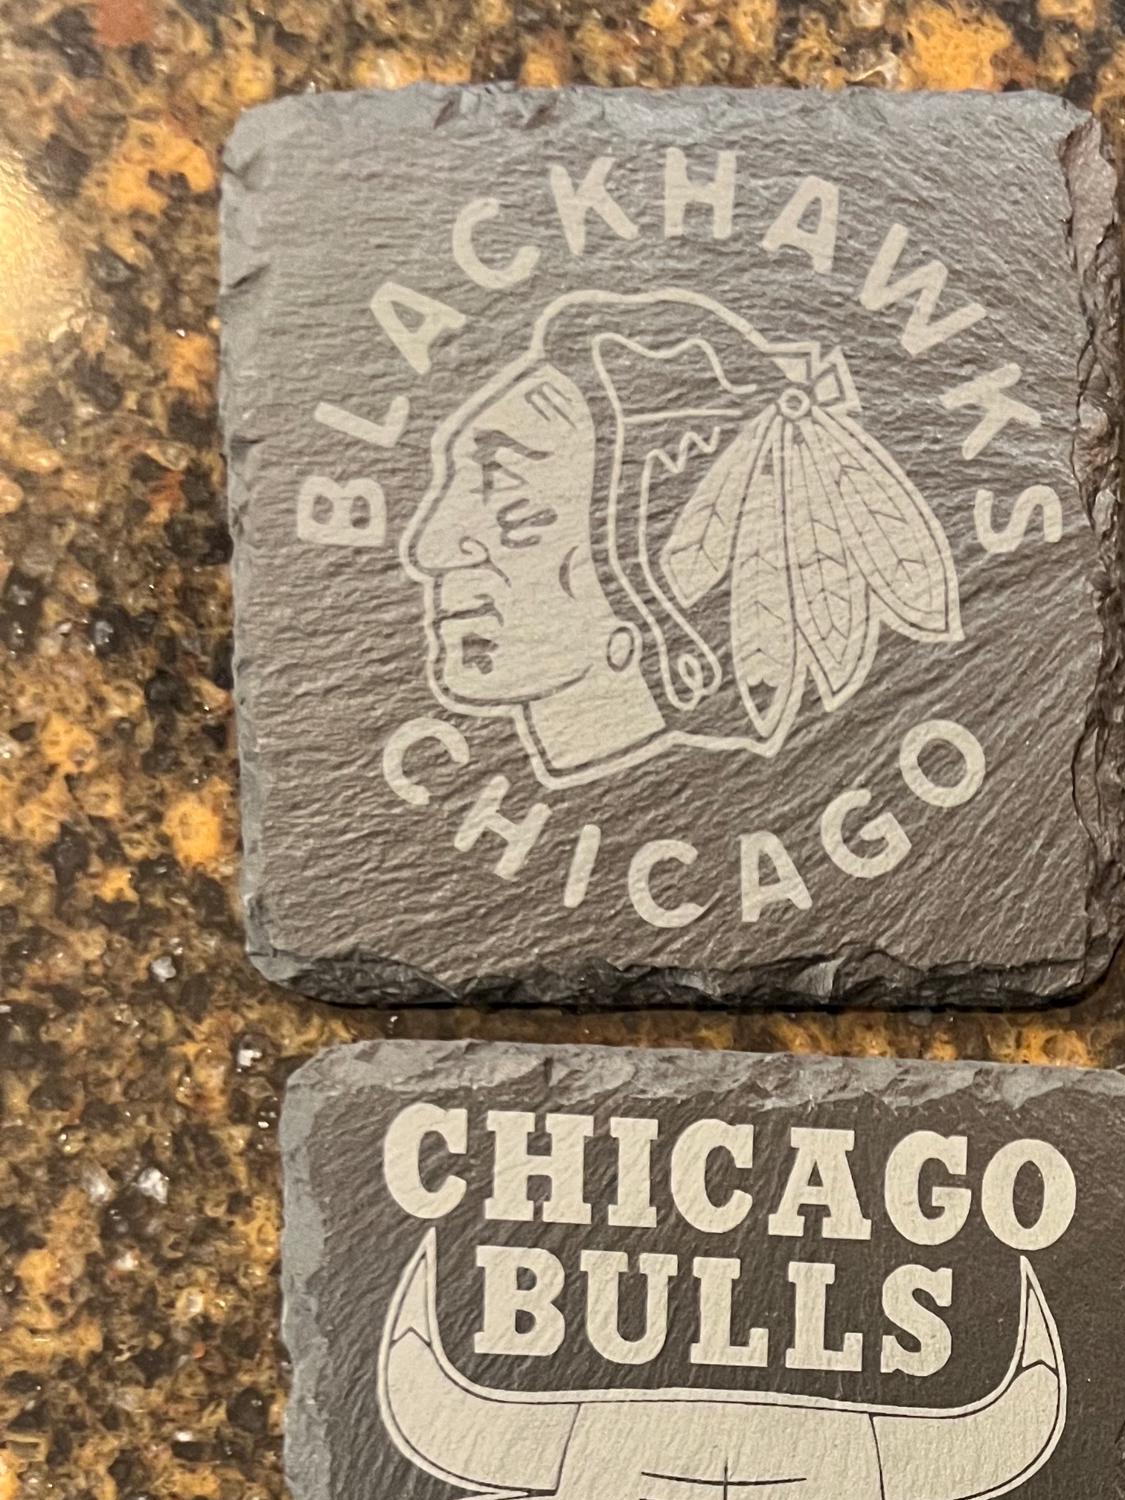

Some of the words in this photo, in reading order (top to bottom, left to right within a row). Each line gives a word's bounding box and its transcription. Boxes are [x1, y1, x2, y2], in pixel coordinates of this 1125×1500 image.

[297, 147, 1065, 554] BLACKHAWKS
[382, 716, 985, 928] CHICAGO
[382, 1102, 1077, 1251] CHICAGO
[473, 1245, 954, 1377] BULLS
